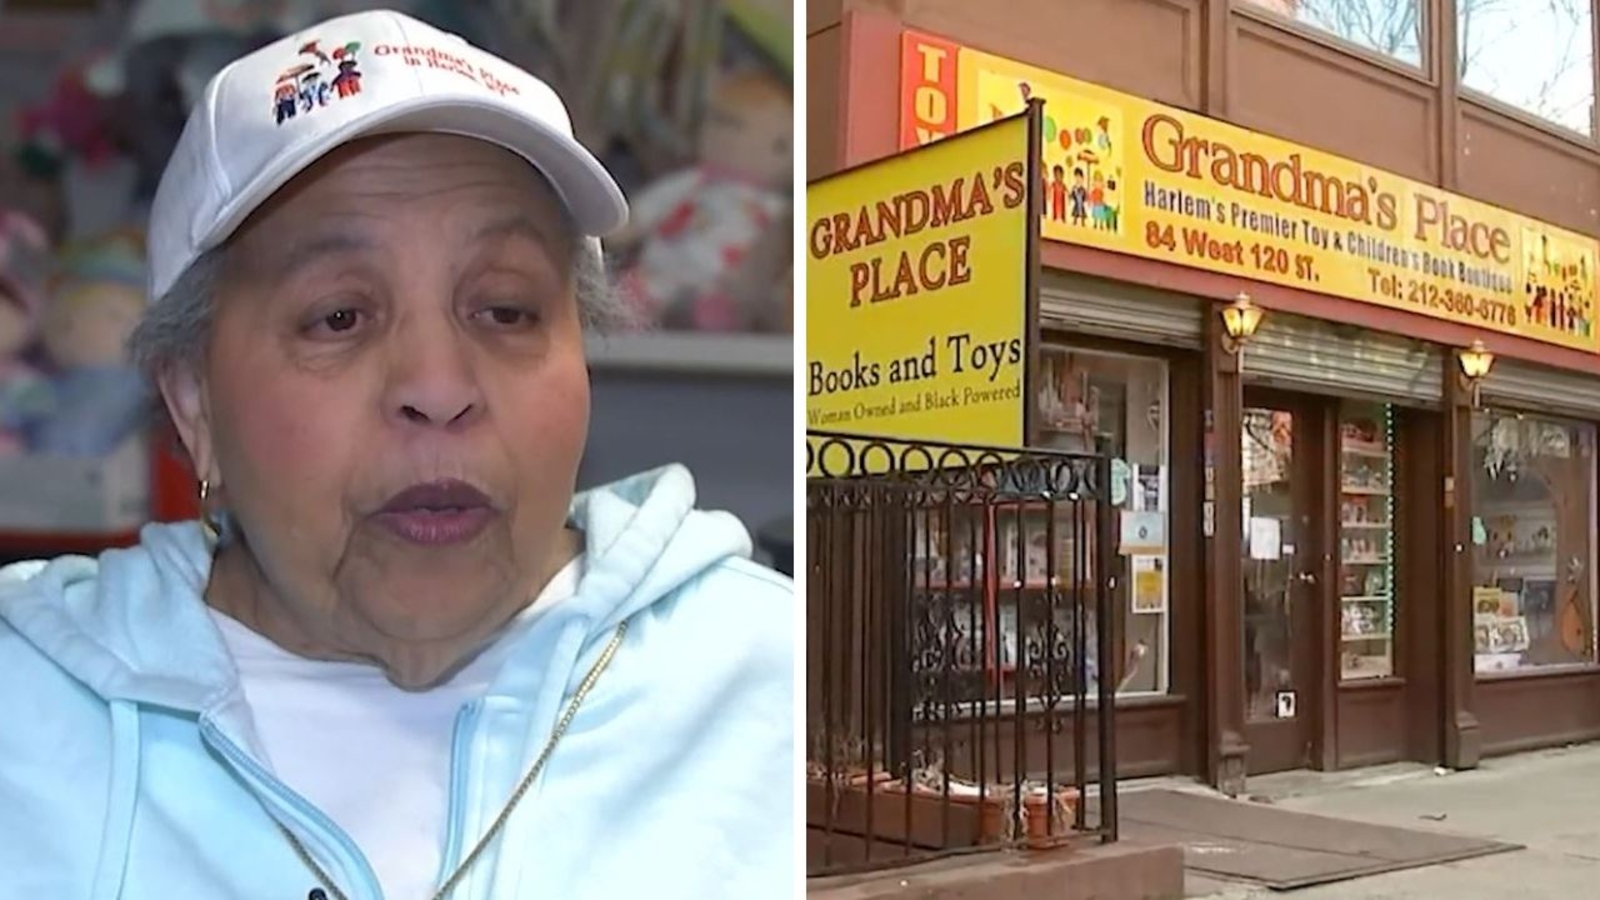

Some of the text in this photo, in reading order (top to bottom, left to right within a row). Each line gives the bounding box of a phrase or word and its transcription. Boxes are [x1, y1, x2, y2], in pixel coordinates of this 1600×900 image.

[809, 162, 1025, 260] GRANDMA'S
[1142, 114, 1512, 265] Grandma's Place
[1144, 180, 1226, 224] Harlem's
[1231, 202, 1297, 241] Premier
[1301, 219, 1329, 250] Toy
[1333, 232, 1343, 251] &
[1346, 230, 1420, 271] Children's
[1423, 252, 1455, 280] Book
[1145, 220, 1177, 252] 84
[1182, 227, 1244, 266] West
[1251, 243, 1289, 275] 120
[1367, 267, 1403, 300] Tel:
[849, 235, 971, 308] PLACE
[807, 378, 1021, 426] Woman Owned and Black Powered
[808, 333, 1022, 396] Books and Toys
